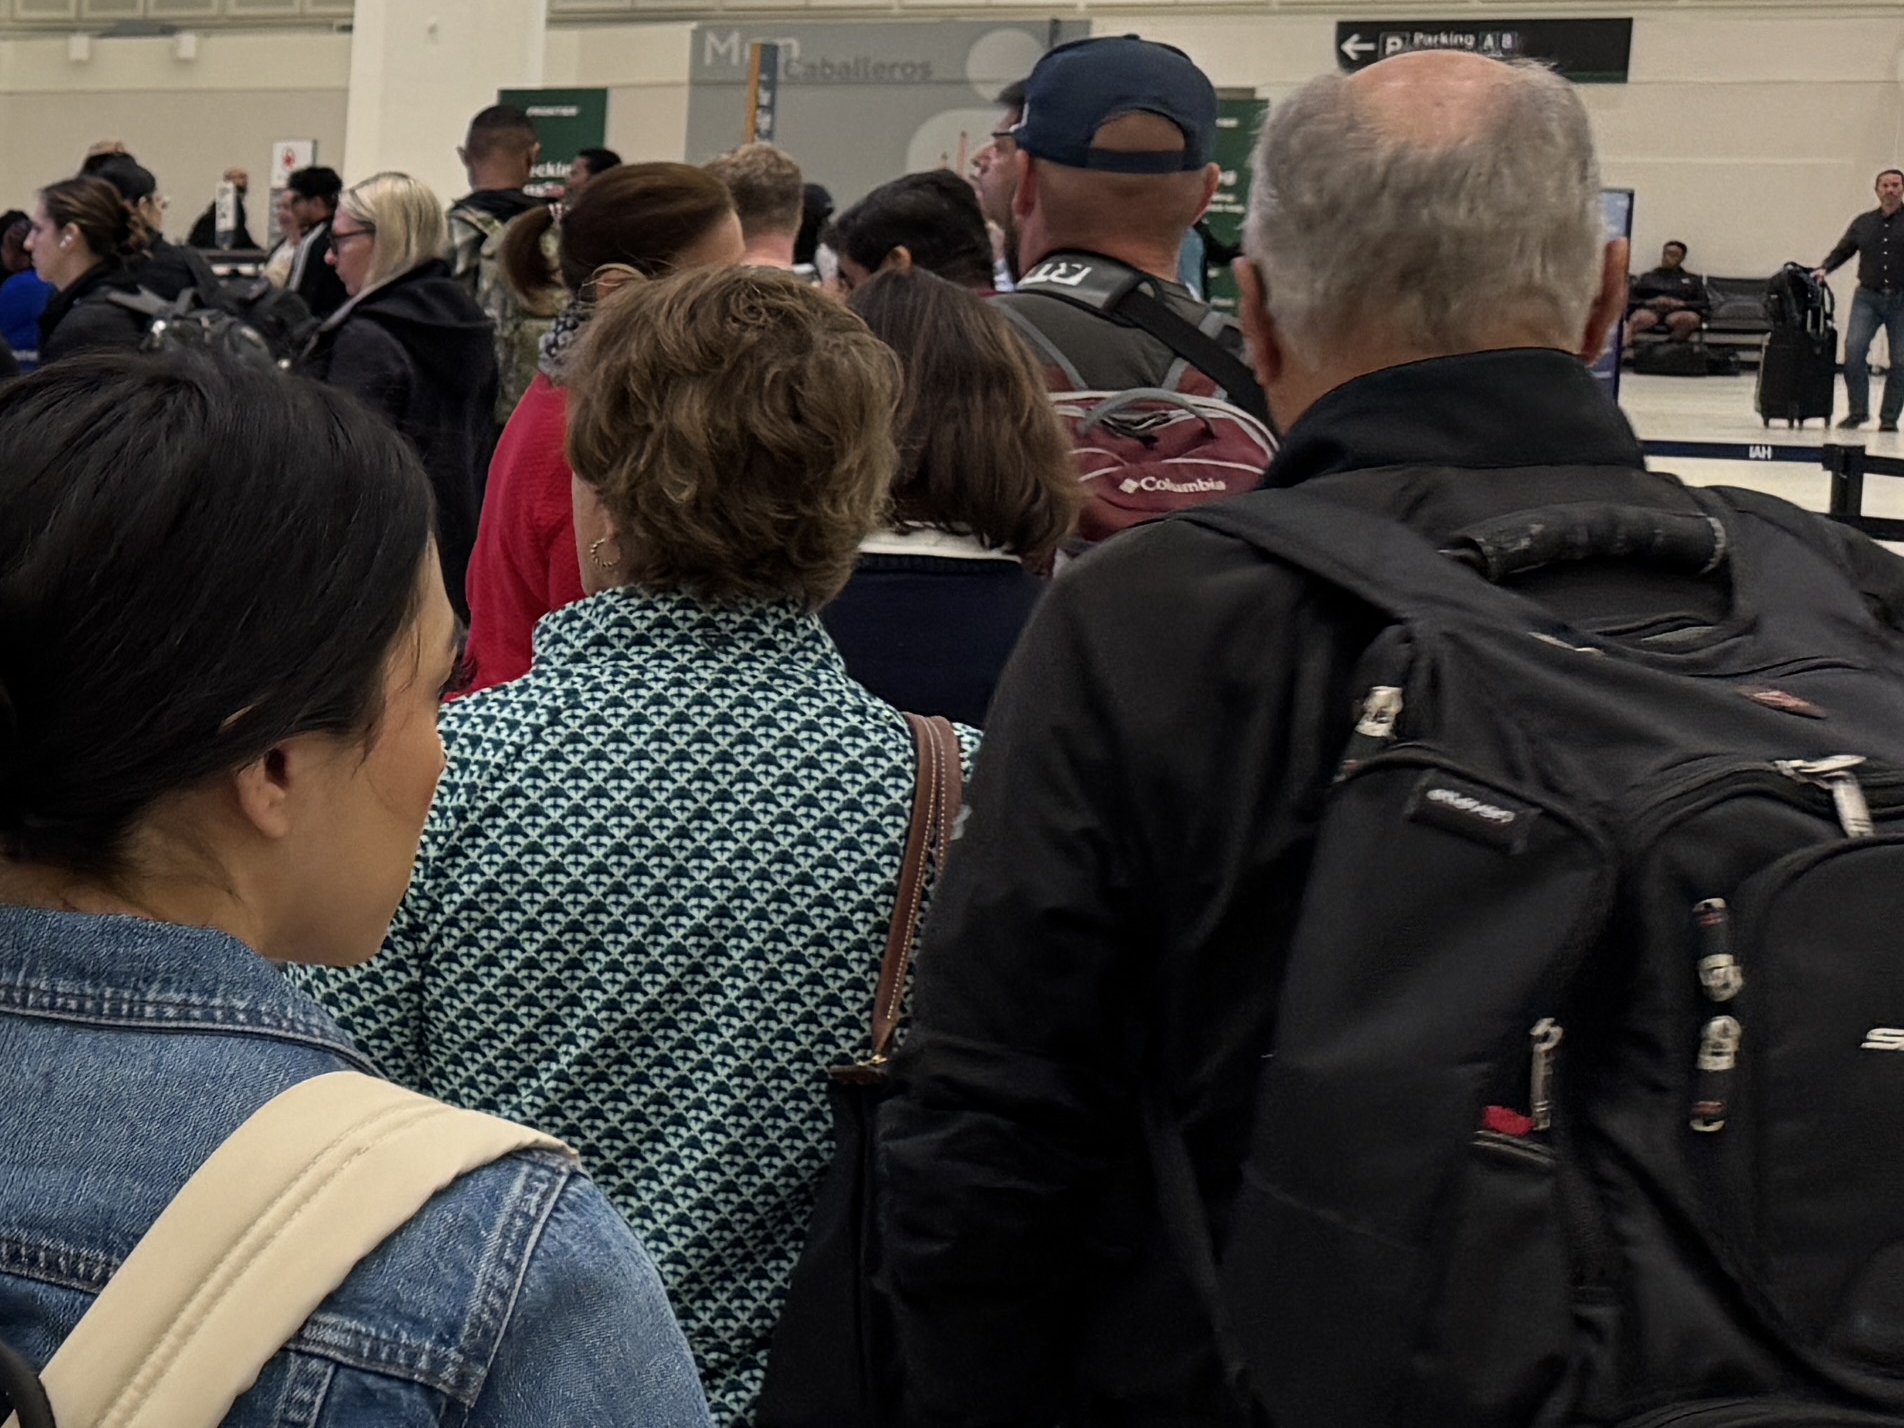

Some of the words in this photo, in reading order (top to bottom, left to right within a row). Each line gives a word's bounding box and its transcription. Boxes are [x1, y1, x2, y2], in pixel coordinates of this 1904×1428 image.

[1413, 31, 1476, 48] Parking
[1483, 34, 1494, 49] A
[784, 56, 932, 81] Caballeros
[1140, 476, 1226, 493] Columbia
